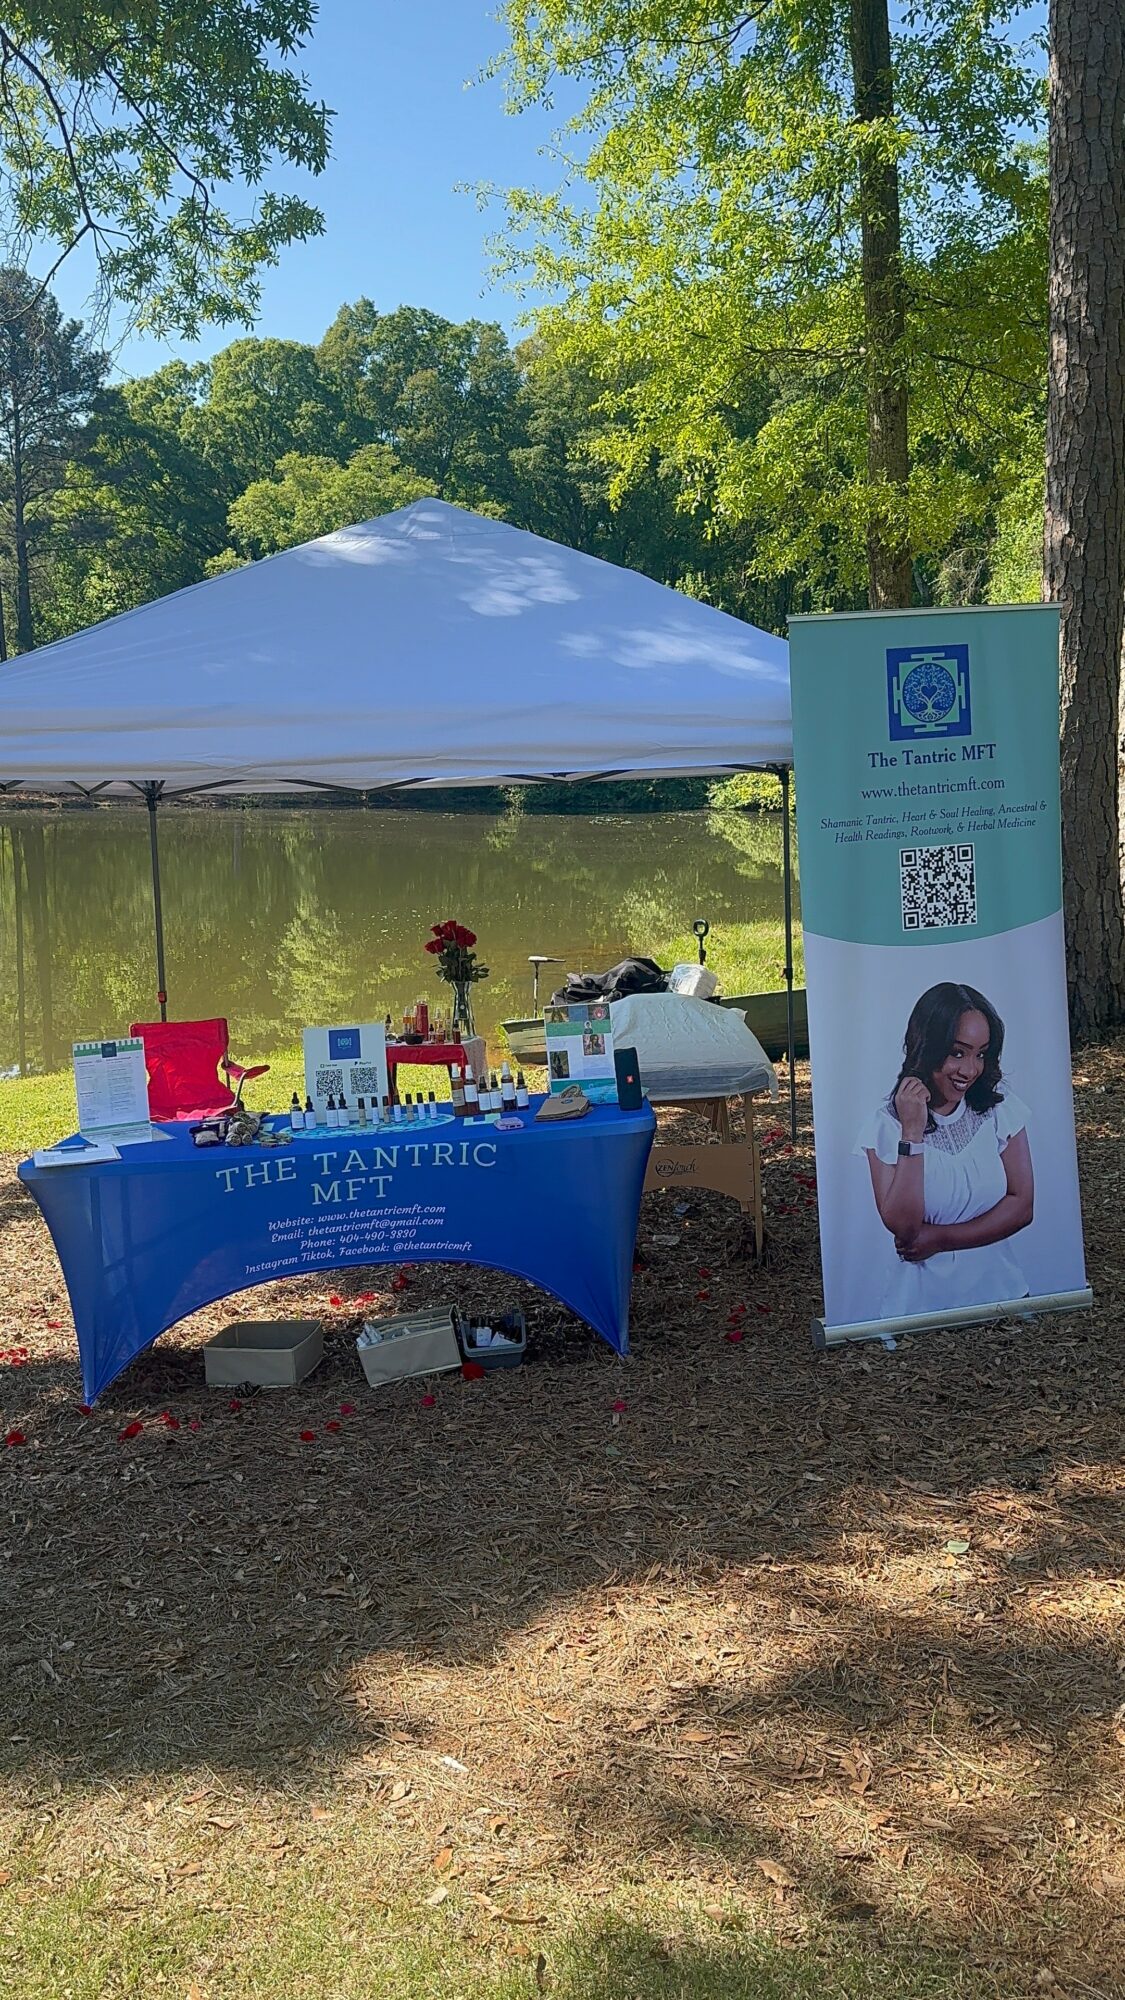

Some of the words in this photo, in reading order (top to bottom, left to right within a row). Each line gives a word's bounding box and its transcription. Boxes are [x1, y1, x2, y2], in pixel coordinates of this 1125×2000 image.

[868, 752, 898, 768] The
[902, 748, 957, 765] Tantric
[962, 743, 997, 761] MFT
[861, 776, 1006, 799] www.thetantricmft.com
[820, 817, 863, 829] Shamanic
[866, 814, 899, 826] Tantric,
[902, 811, 927, 822] Heart
[929, 809, 938, 820] &
[940, 808, 959, 819] Soul
[961, 805, 996, 818] Healing,
[998, 801, 1038, 814] Ancestral
[1039, 800, 1048, 811] &
[834, 831, 863, 844] Health
[865, 828, 908, 841] Readings,
[910, 823, 954, 836] Rootwork,
[956, 821, 965, 833] &
[967, 819, 996, 832] Herbal
[997, 817, 1037, 829] Medicine
[215, 1156, 297, 1193] THE
[313, 1142, 497, 1176] TANTRIC
[311, 1175, 393, 1205] MFT
[268, 1217, 314, 1231] Website:
[318, 1203, 446, 1223] www.thetantricmft.com
[271, 1229, 304, 1243] Email:
[308, 1216, 444, 1236] thetantricmft@gmail.com
[245, 1256, 298, 1275] Instagram
[301, 1248, 335, 1262] Tiktok,
[339, 1242, 390, 1257] Facebook:
[393, 1240, 472, 1252] @thetantricmft
[300, 1238, 335, 1250] Phone:
